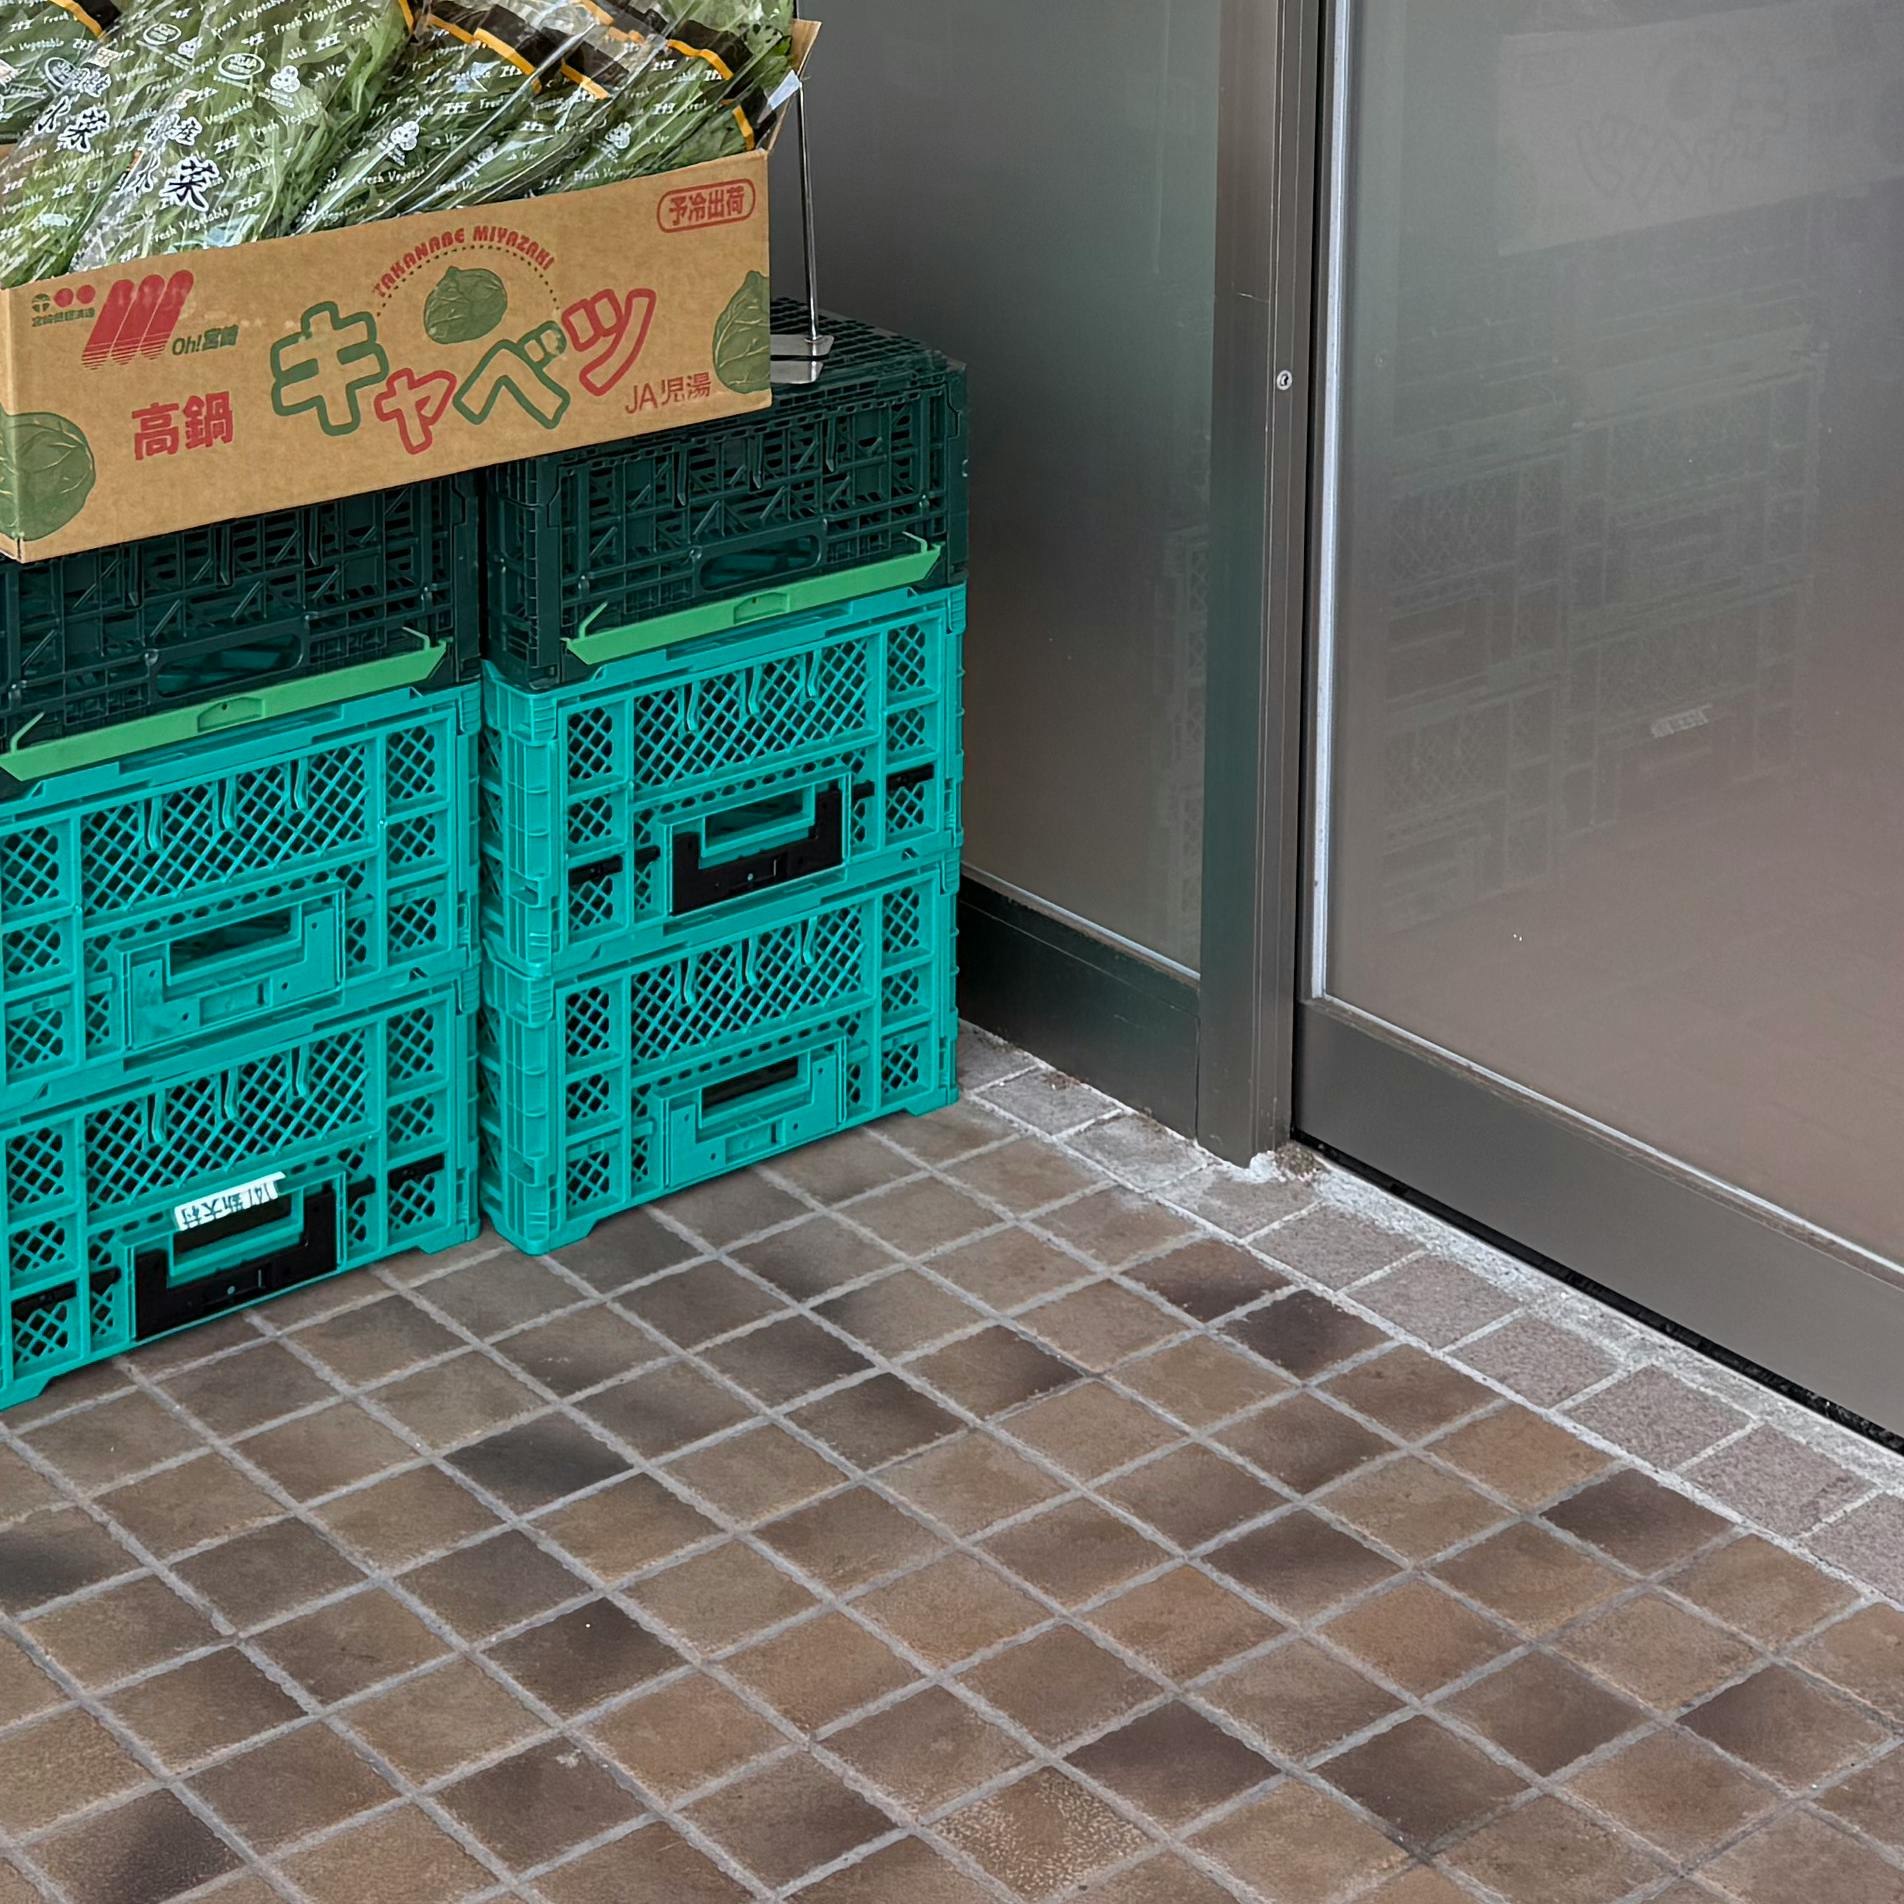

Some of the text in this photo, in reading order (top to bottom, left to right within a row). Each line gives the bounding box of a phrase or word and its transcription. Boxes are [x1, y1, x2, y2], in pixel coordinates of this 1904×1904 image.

[668, 185, 746, 227] 予冷出荷
[372, 225, 557, 296] TAKANABE MIYAZAKI
[271, 288, 657, 455] キャベツ
[625, 371, 712, 414] JA児湯
[131, 391, 233, 460] 高鍋
